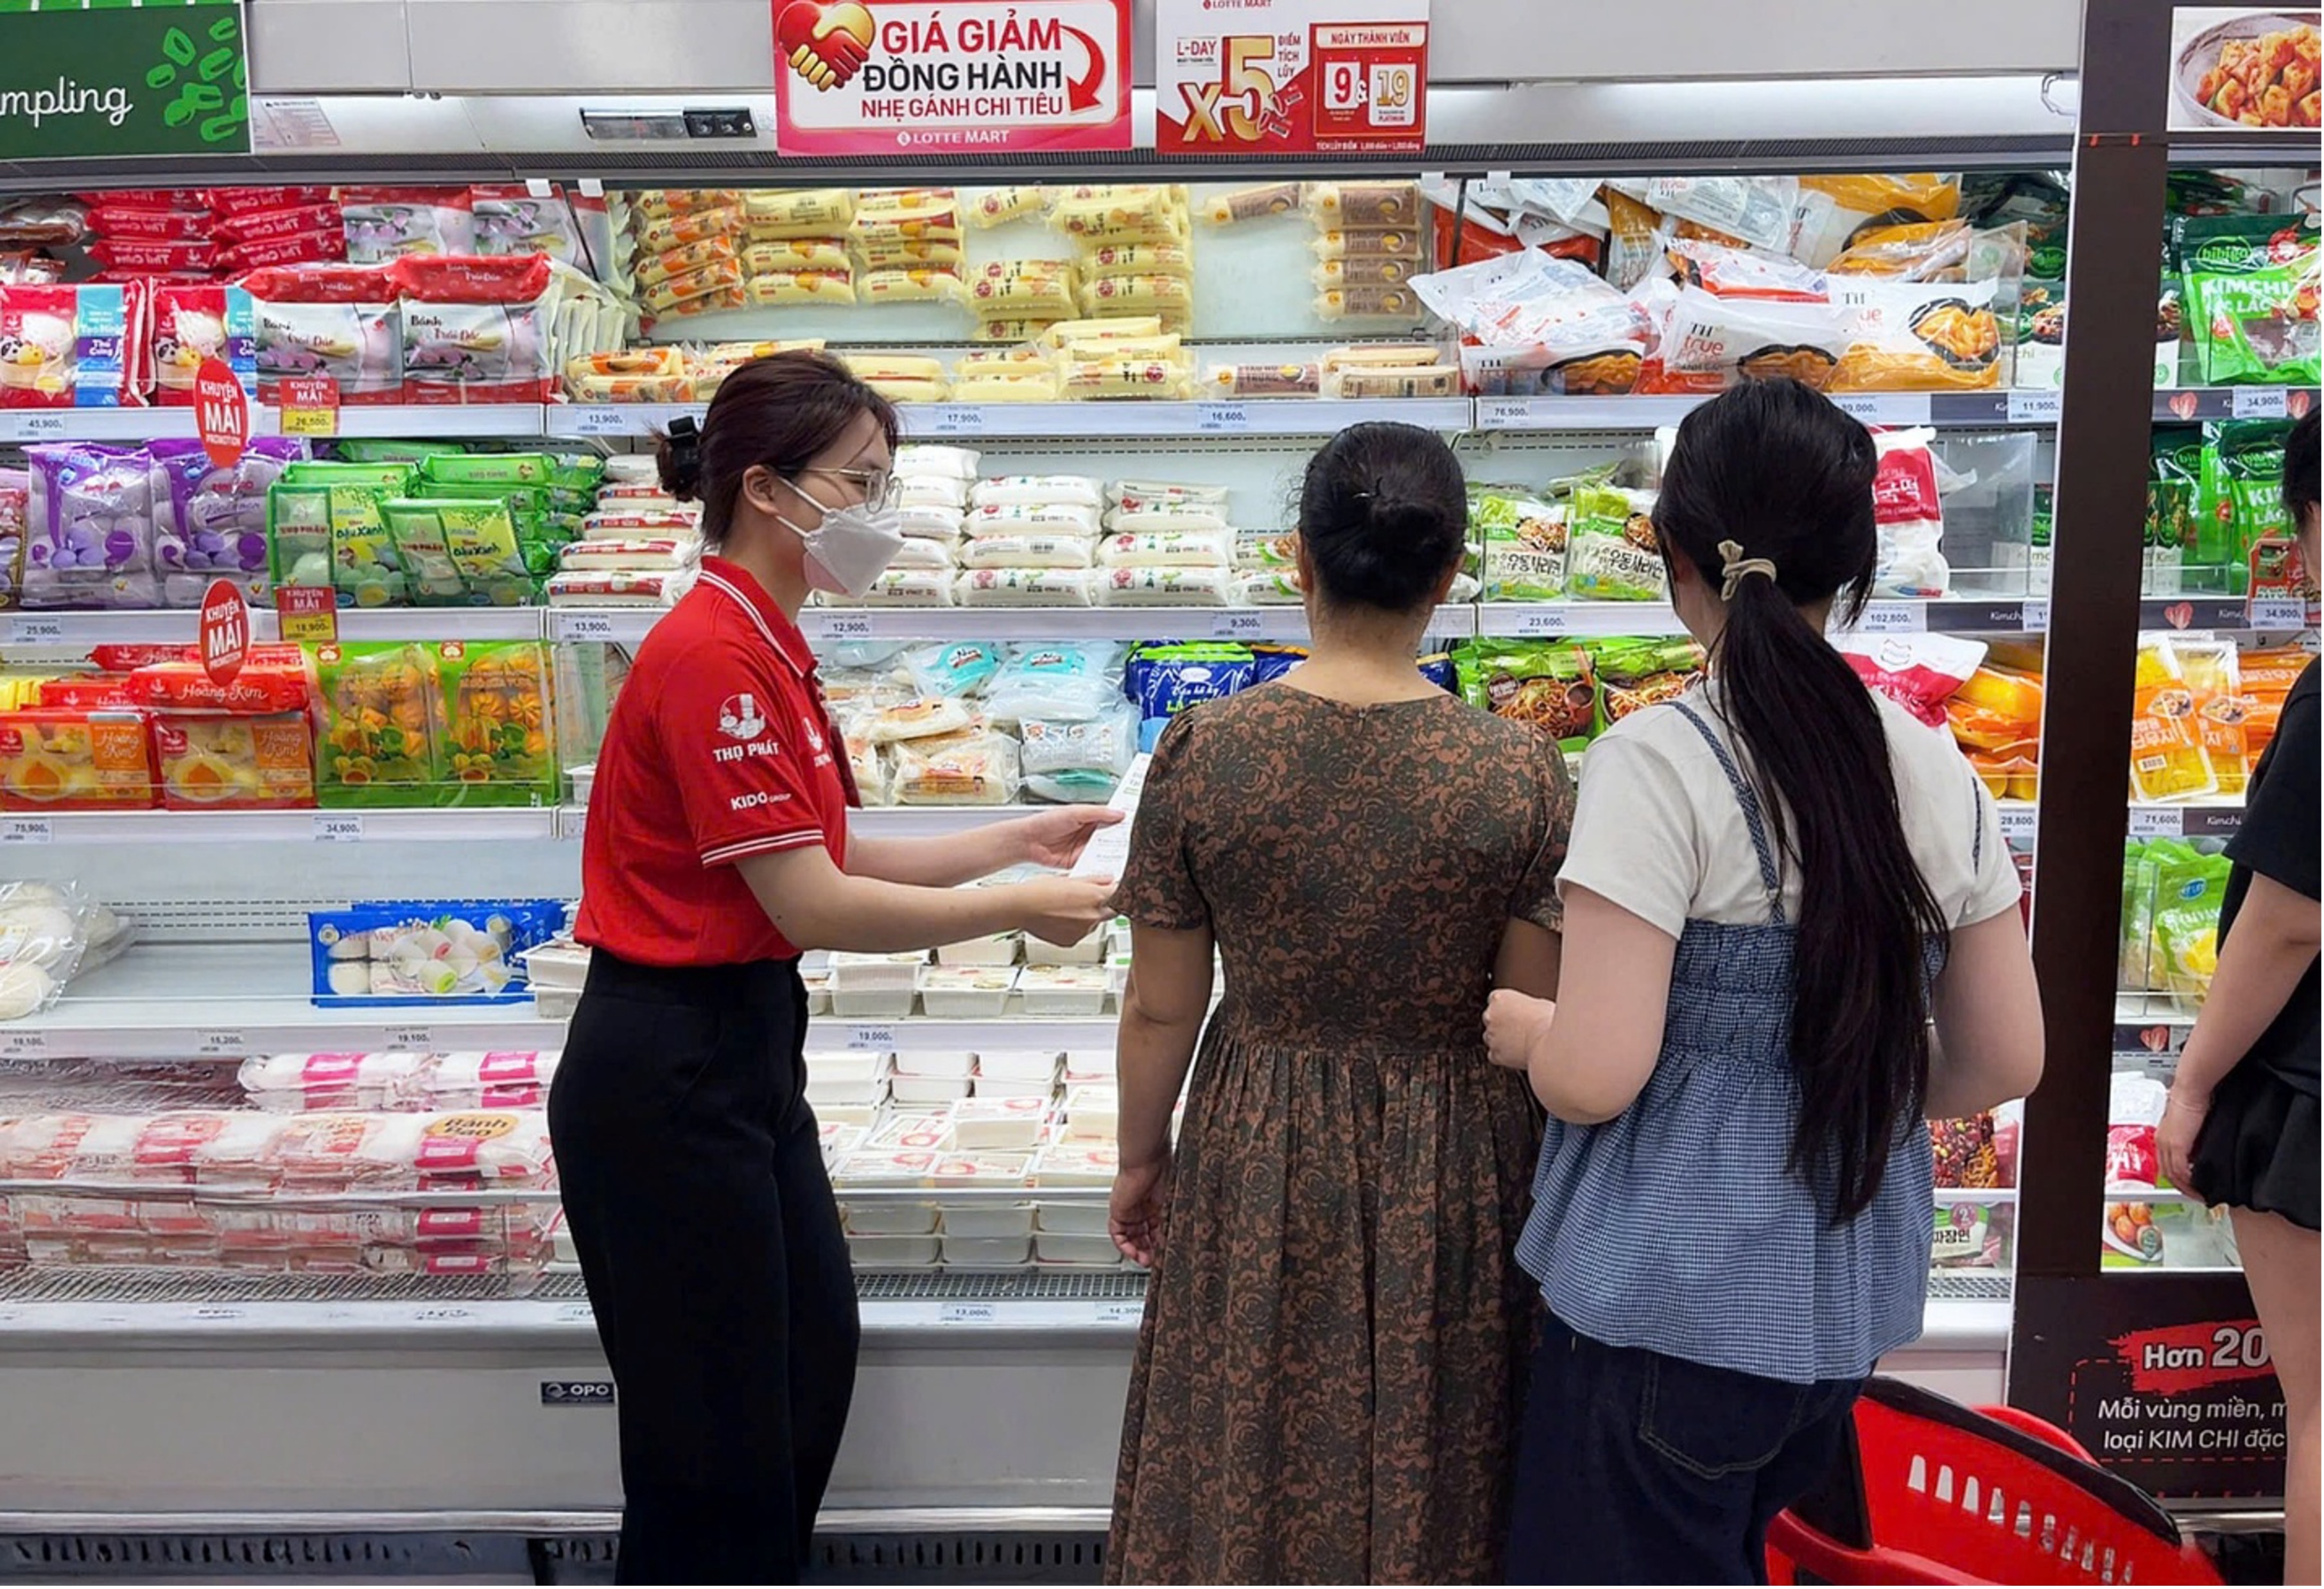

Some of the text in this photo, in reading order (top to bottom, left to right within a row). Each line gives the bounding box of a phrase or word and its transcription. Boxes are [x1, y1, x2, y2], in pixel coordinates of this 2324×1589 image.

[881, 9, 1062, 54] GIÁ GIẢM
[1331, 31, 1357, 44] NGÀY
[1358, 30, 1389, 44] THÀNH
[1177, 40, 1217, 56] L-DAY
[1279, 48, 1299, 62] TÍCH
[863, 54, 1061, 92] ĐỒNG HÀNH
[1335, 67, 1351, 103] 9
[1376, 69, 1410, 107] 19
[862, 94, 1063, 122] NHẸ GÁNH CHI TIÊU
[912, 130, 1010, 144] LOTTE MART
[1684, 335, 1724, 356] true
[200, 379, 239, 399] KHUYẾN
[290, 380, 329, 392] KHUYẾN
[204, 397, 241, 435] MÃI
[205, 597, 239, 623] KHUYẾN
[208, 616, 243, 659] MÃI
[180, 682, 269, 704] Hoàng Kim
[713, 740, 779, 763] THỌ PHÁT
[731, 791, 768, 811] KIDO
[2206, 815, 2242, 827] Kimchi
[2144, 1326, 2271, 1370] Hơn 20
[569, 1383, 610, 1398] OPO
[2097, 1397, 2140, 1420] Mỗi
[2146, 1398, 2201, 1423] vùng
[2207, 1395, 2266, 1421] miền,
[2104, 1428, 2285, 1453] loại KIM CHI đặc
